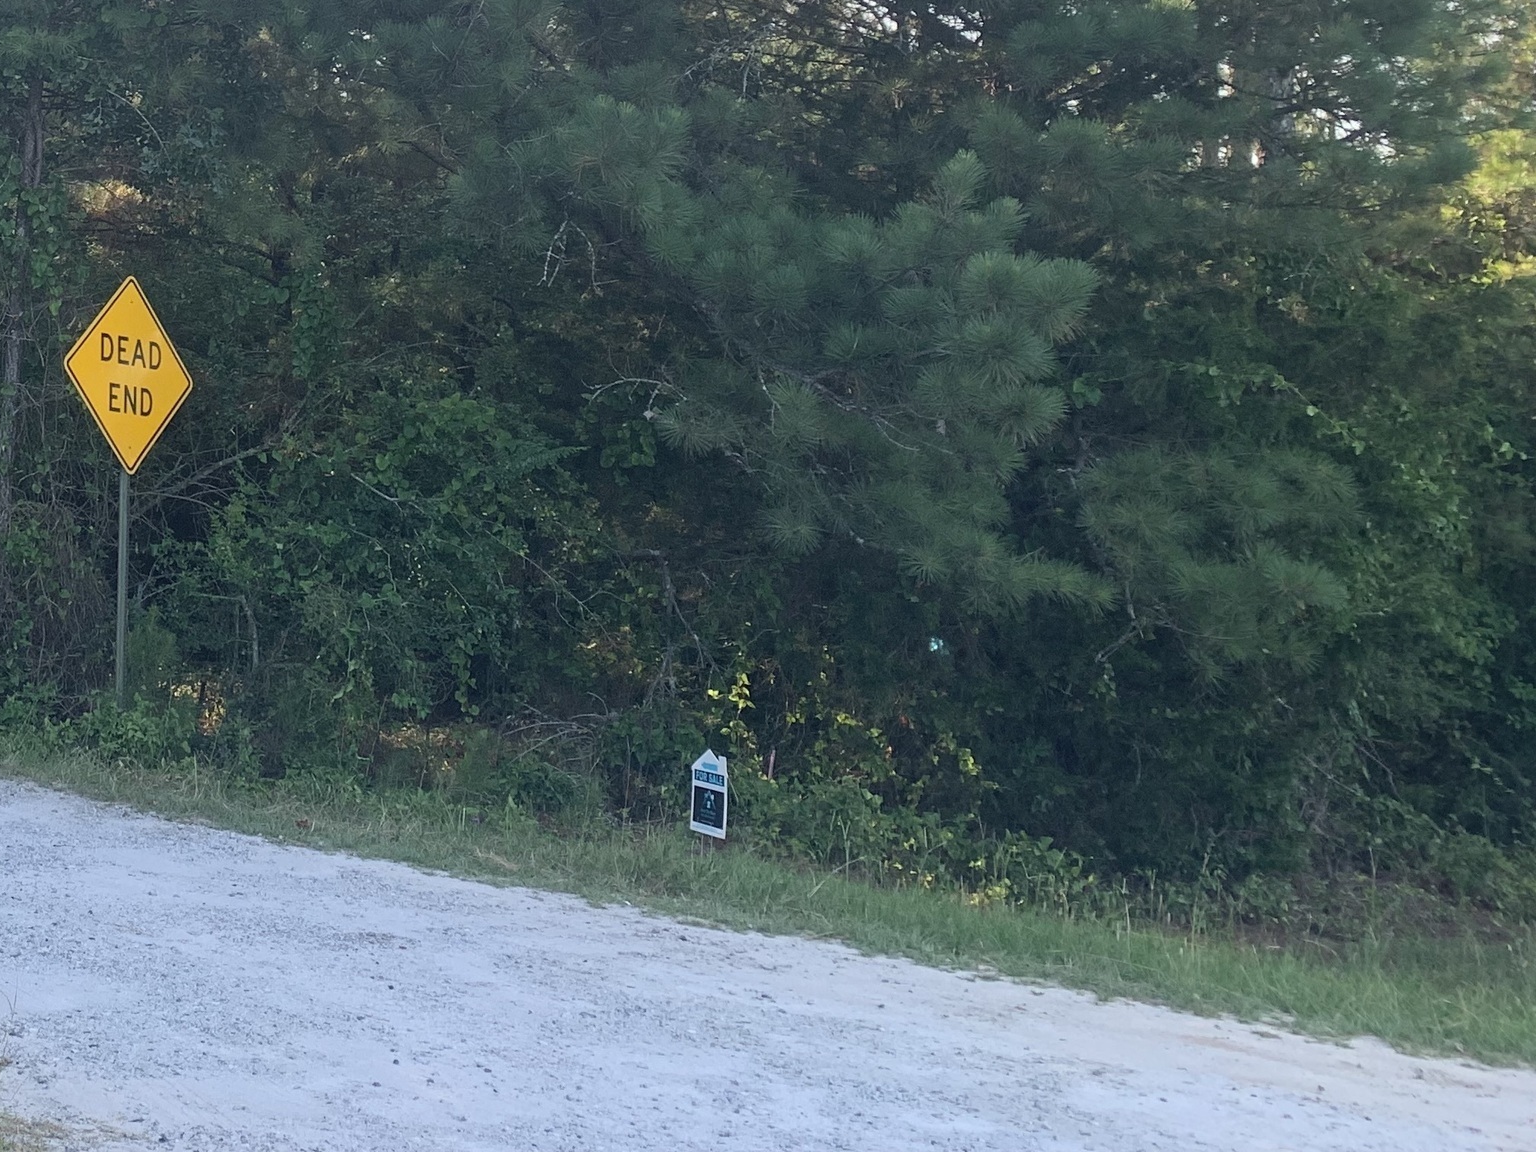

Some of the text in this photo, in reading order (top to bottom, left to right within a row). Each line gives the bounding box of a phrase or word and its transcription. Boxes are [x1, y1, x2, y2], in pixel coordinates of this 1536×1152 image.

[101, 333, 161, 370] DEAD
[109, 382, 153, 416] END
[695, 770, 723, 786] FOR SALE
